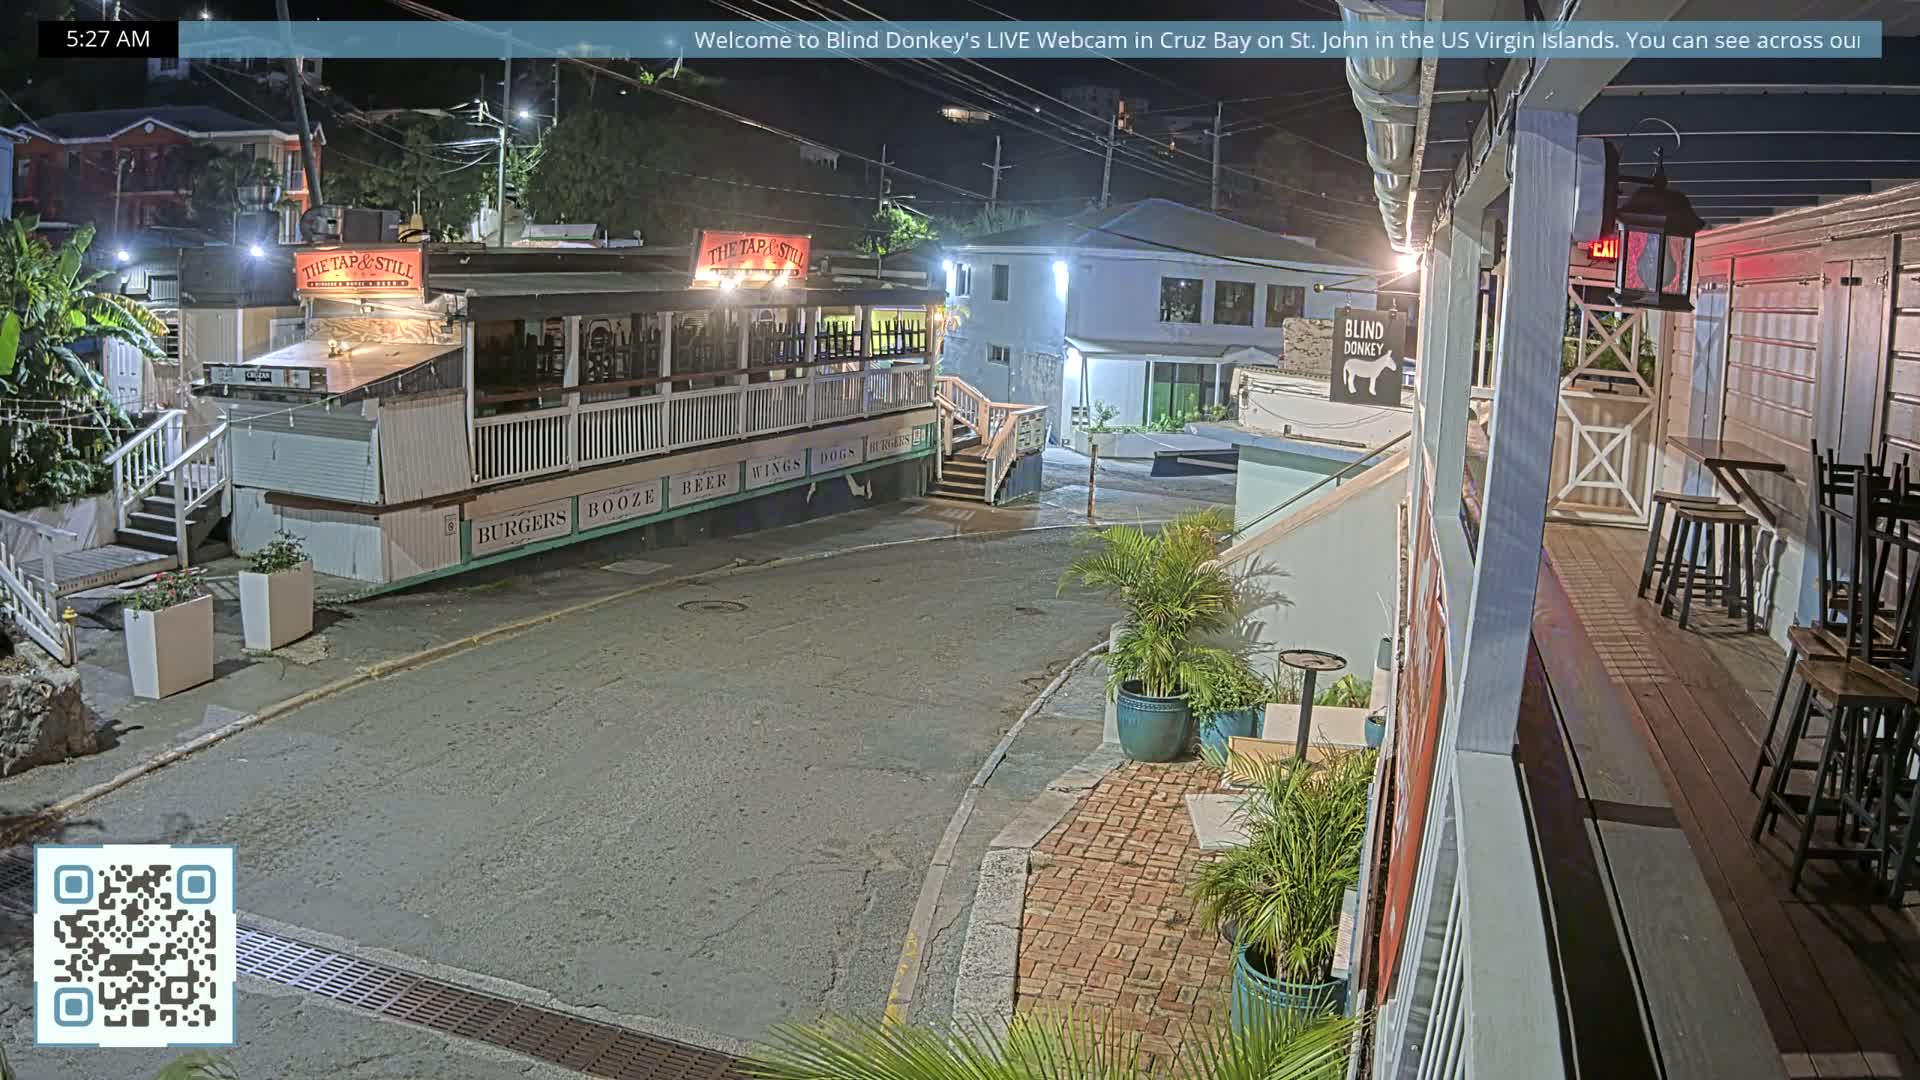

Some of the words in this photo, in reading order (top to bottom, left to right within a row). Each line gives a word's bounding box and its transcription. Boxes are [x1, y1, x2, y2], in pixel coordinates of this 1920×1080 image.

[708, 241, 737, 266] THE
[738, 238, 765, 256] TAP
[778, 242, 805, 269] STILL
[302, 258, 329, 280] THE
[330, 255, 359, 270] TAP
[374, 256, 414, 280] STILL
[1345, 319, 1384, 340] BLIND
[1344, 341, 1384, 357] DONKEY
[869, 434, 911, 454] BURGERS
[820, 448, 855, 465] DOGS
[752, 458, 801, 480] WINGS
[682, 473, 728, 496] BEER
[588, 489, 655, 518] BOOZE
[478, 510, 567, 545] BURGERS
